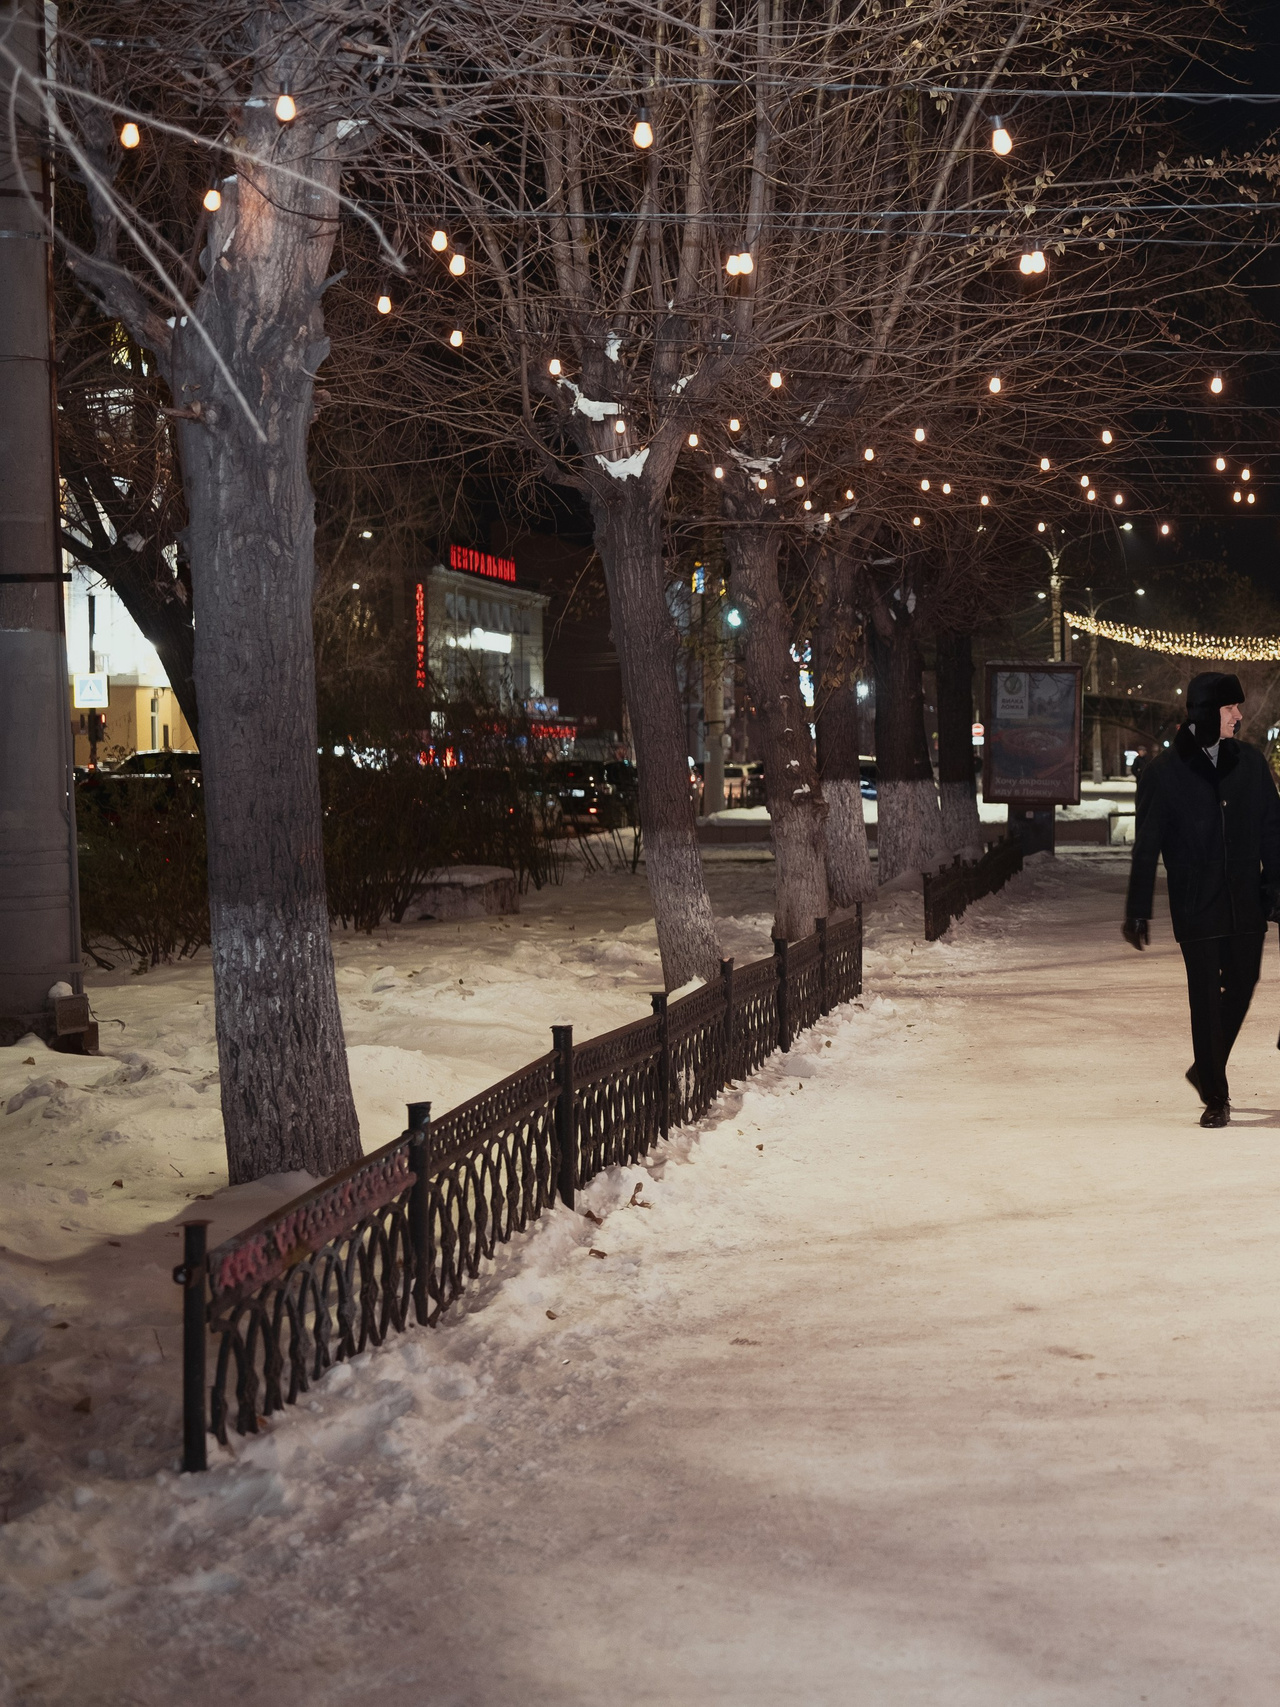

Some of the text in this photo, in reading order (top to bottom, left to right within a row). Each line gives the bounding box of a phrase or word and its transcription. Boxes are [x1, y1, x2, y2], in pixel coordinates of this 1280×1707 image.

[450, 544, 516, 582] ЦЕНТРАЛЬНЫЙ
[995, 776, 1062, 787] Хочу окрошку
[995, 788, 1013, 797] иду
[1022, 788, 1053, 798] Ложку
